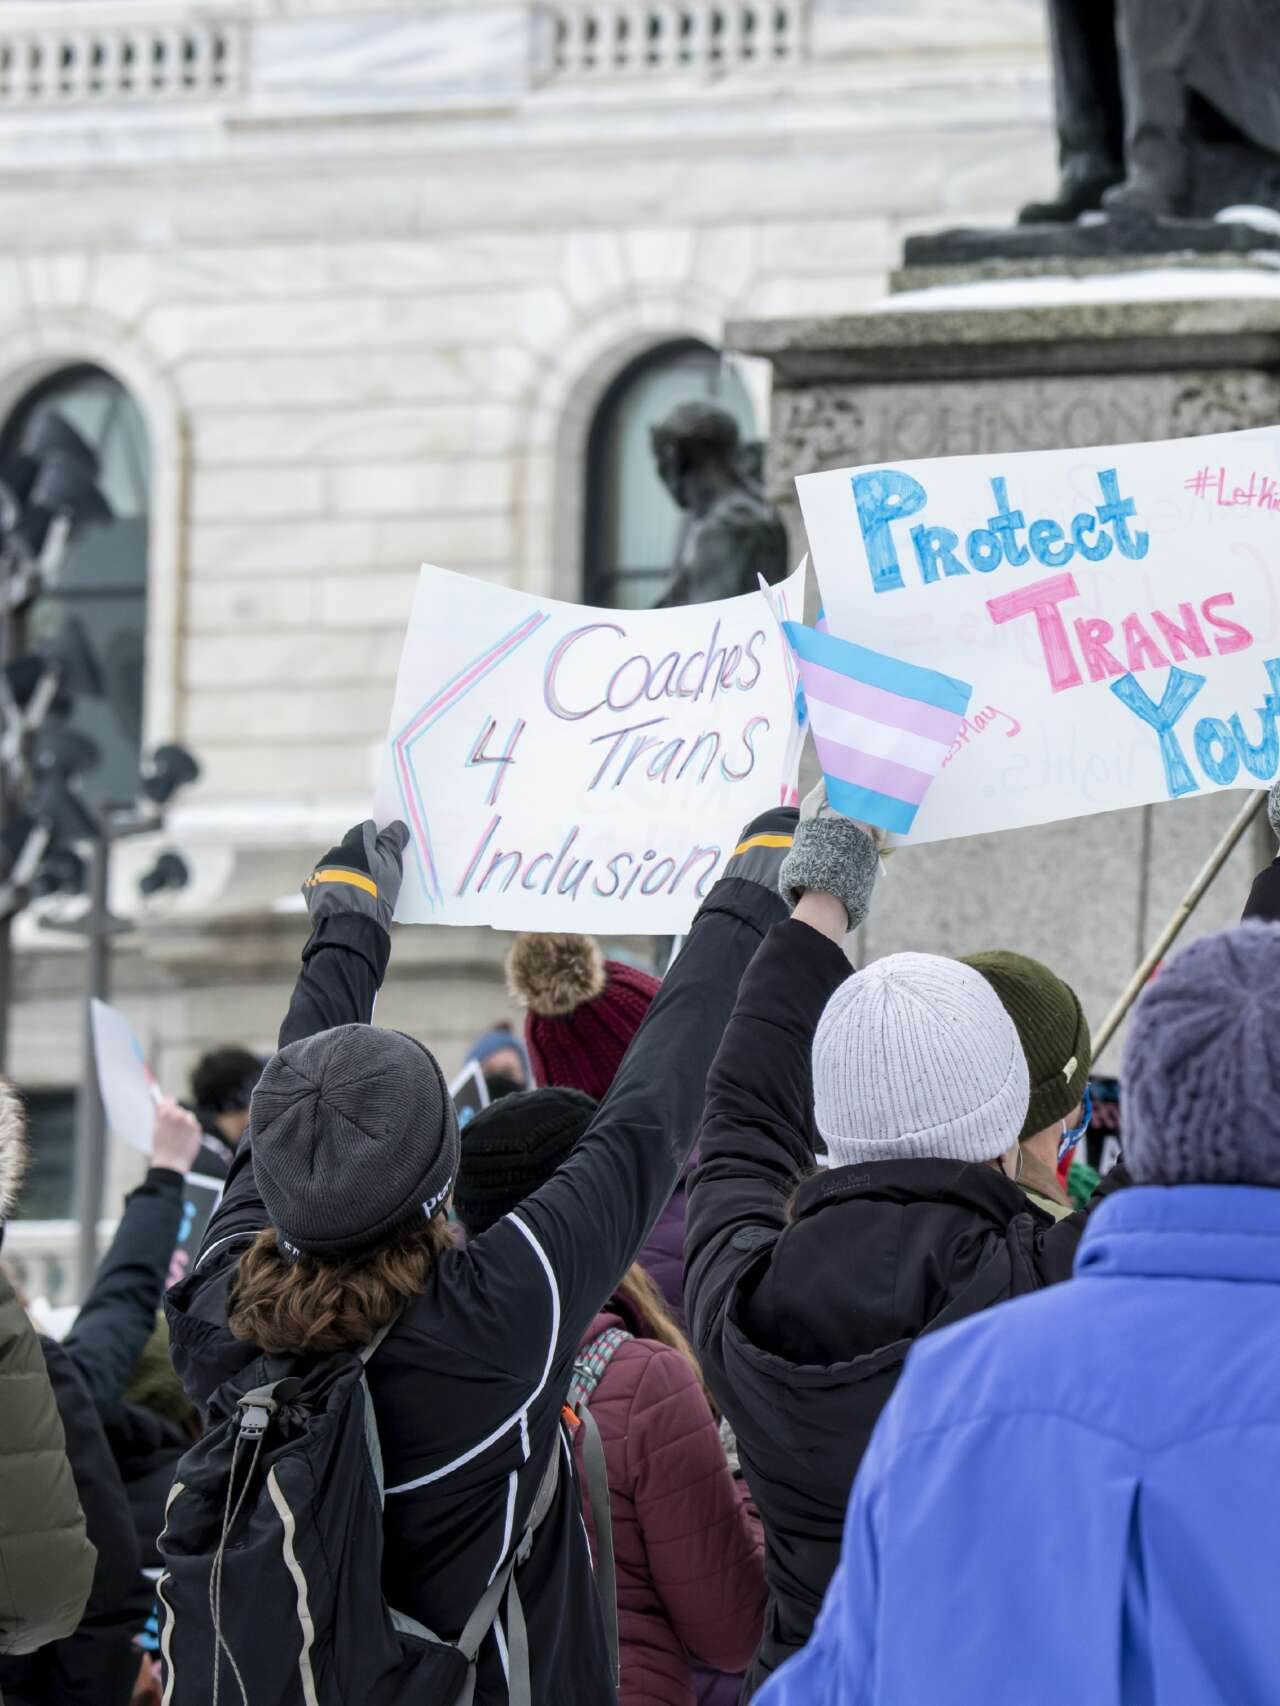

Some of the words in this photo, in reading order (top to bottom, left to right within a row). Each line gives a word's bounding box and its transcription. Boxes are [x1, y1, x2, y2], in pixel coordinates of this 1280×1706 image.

[543, 617, 767, 721] Coaches
[464, 714, 526, 806] 4
[587, 716, 770, 791] Trans
[455, 814, 721, 901] Inclusion
